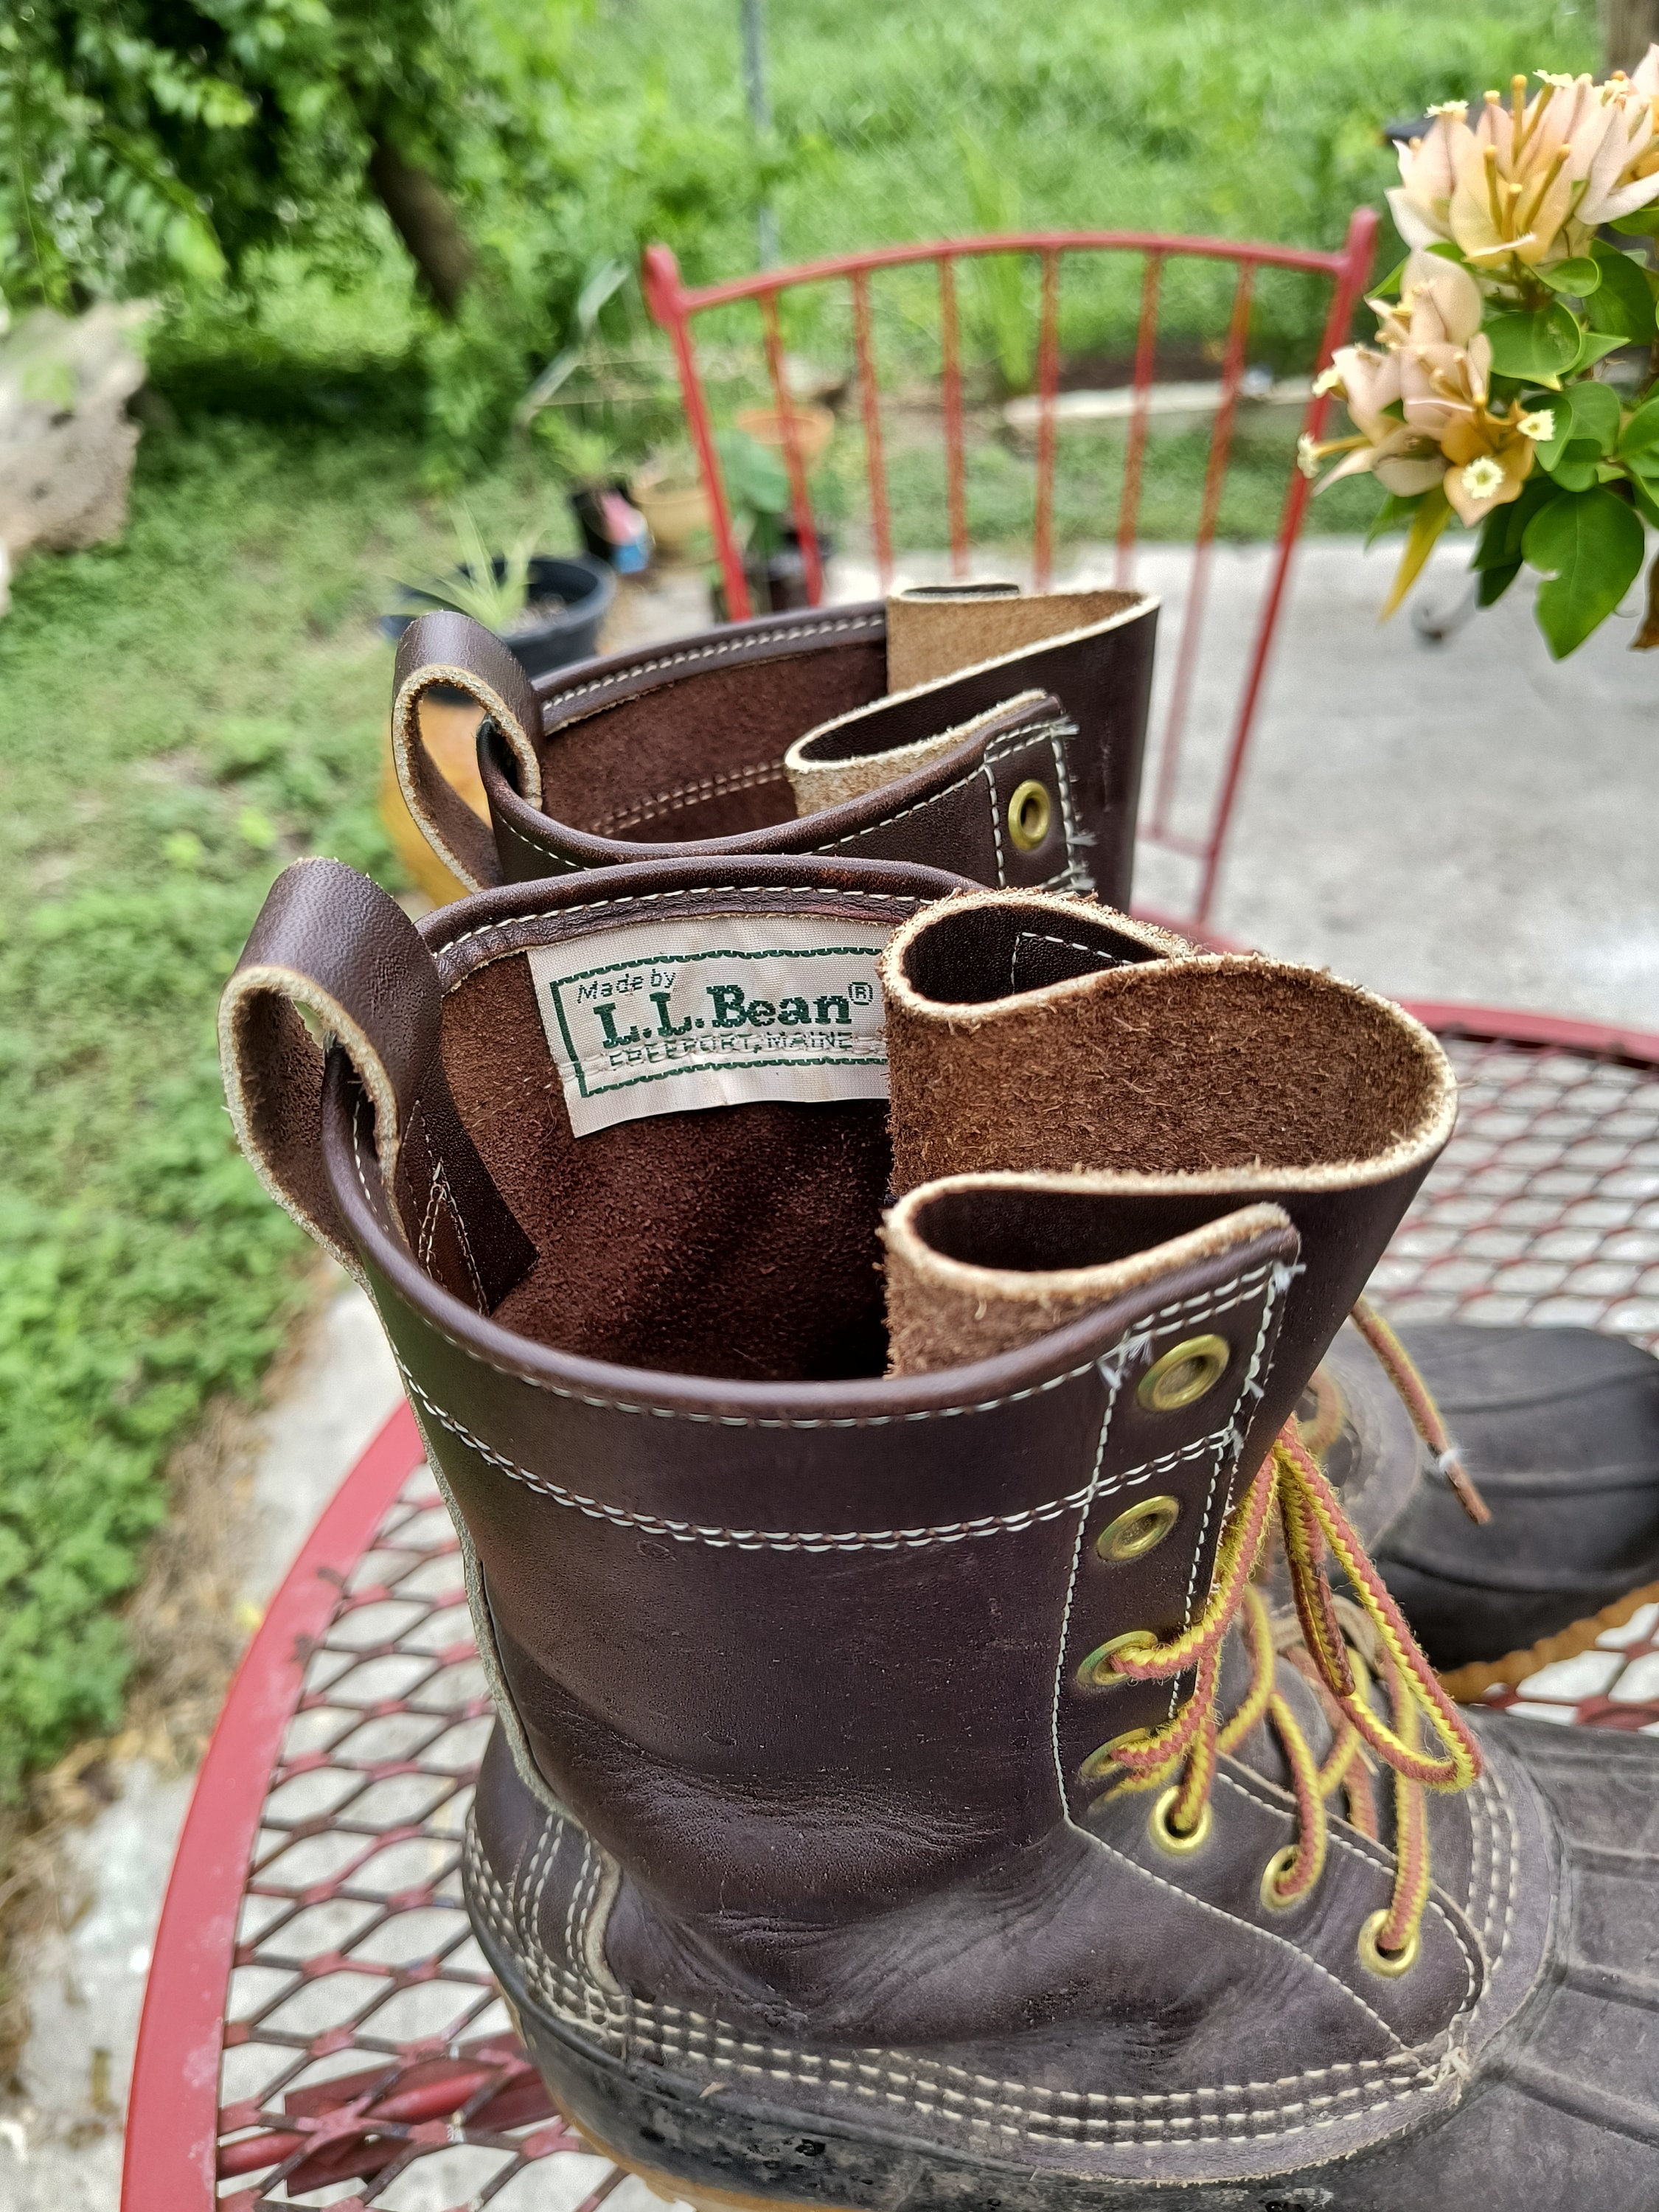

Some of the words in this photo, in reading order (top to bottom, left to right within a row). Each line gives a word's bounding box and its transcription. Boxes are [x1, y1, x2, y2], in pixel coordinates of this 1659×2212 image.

[577, 973, 644, 1004] Made
[650, 968, 676, 990] by
[765, 1032, 853, 1050] MAINE
